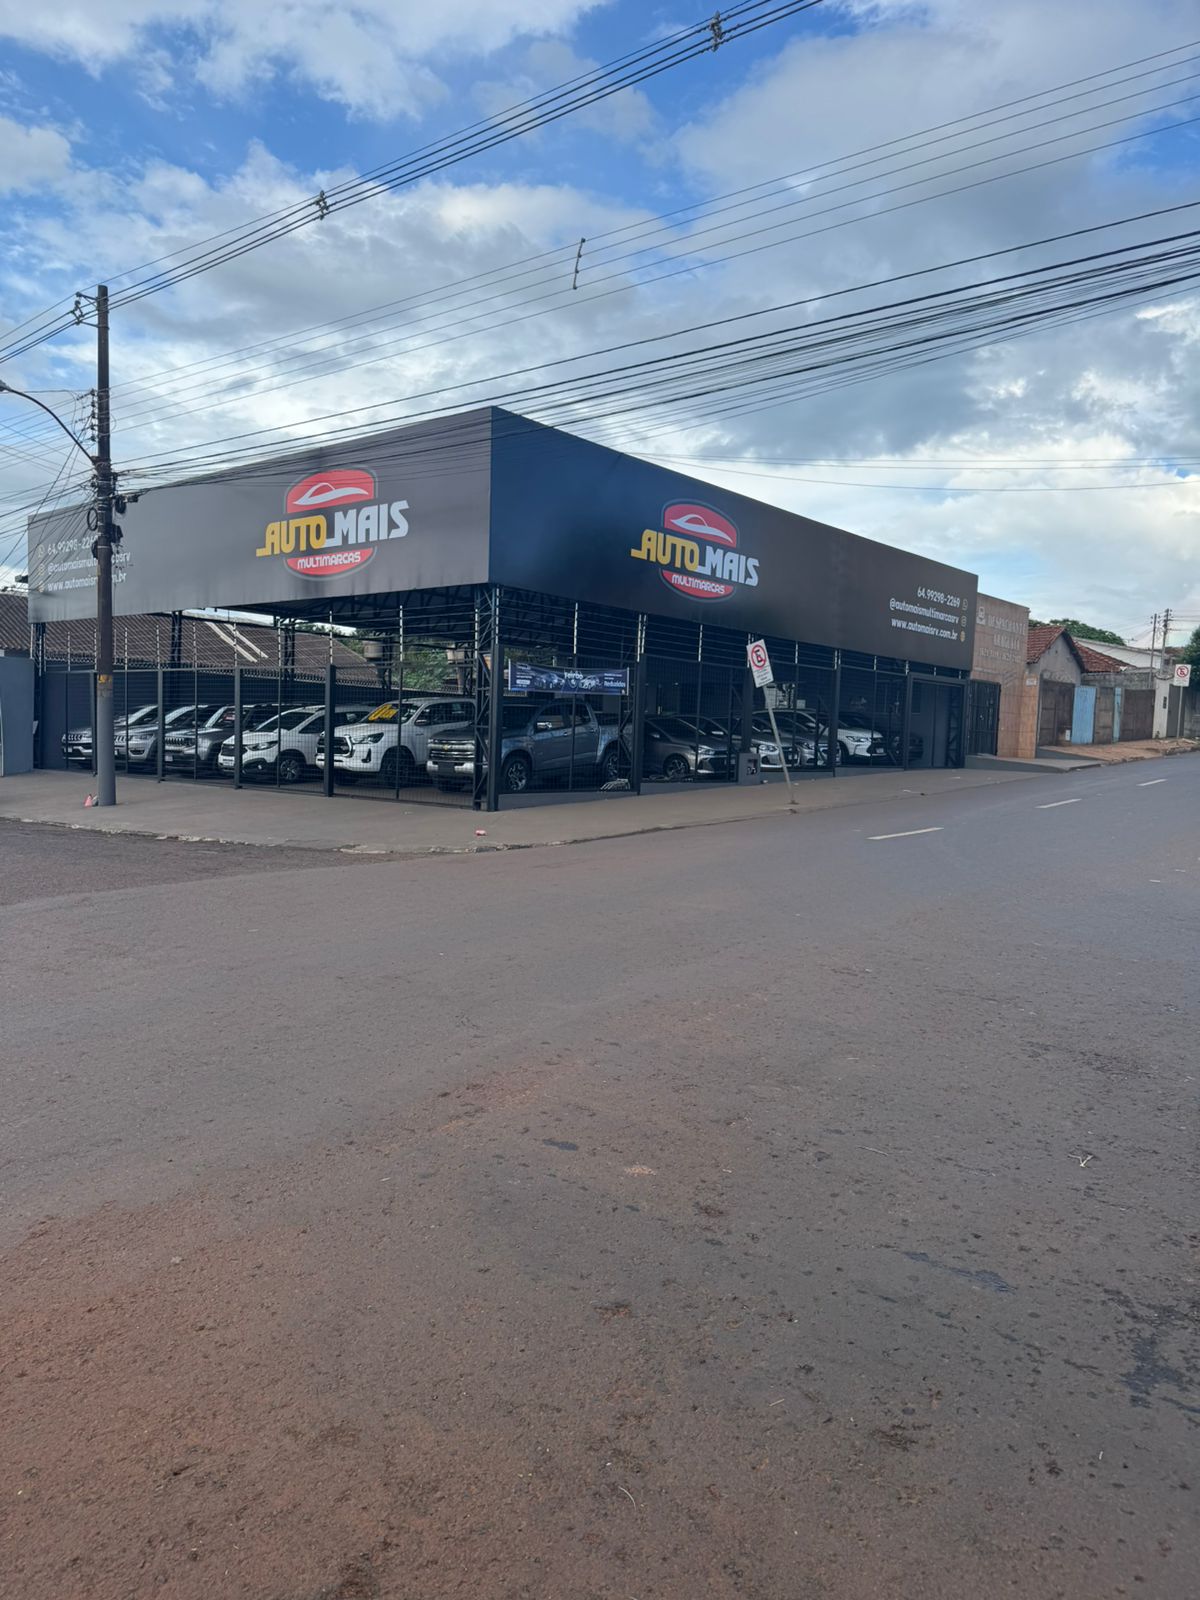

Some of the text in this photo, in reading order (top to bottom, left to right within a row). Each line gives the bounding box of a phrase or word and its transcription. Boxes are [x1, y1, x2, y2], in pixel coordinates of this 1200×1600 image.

[256, 499, 410, 557] AUTO MAIS
[297, 551, 362, 569] MULTIMARCAS
[630, 529, 760, 587] AUTO MAIS
[672, 574, 725, 594] MULTIMARCAS
[917, 586, 960, 608] 64.99298-2269
[891, 618, 958, 640] www.automaisrv.com.br
